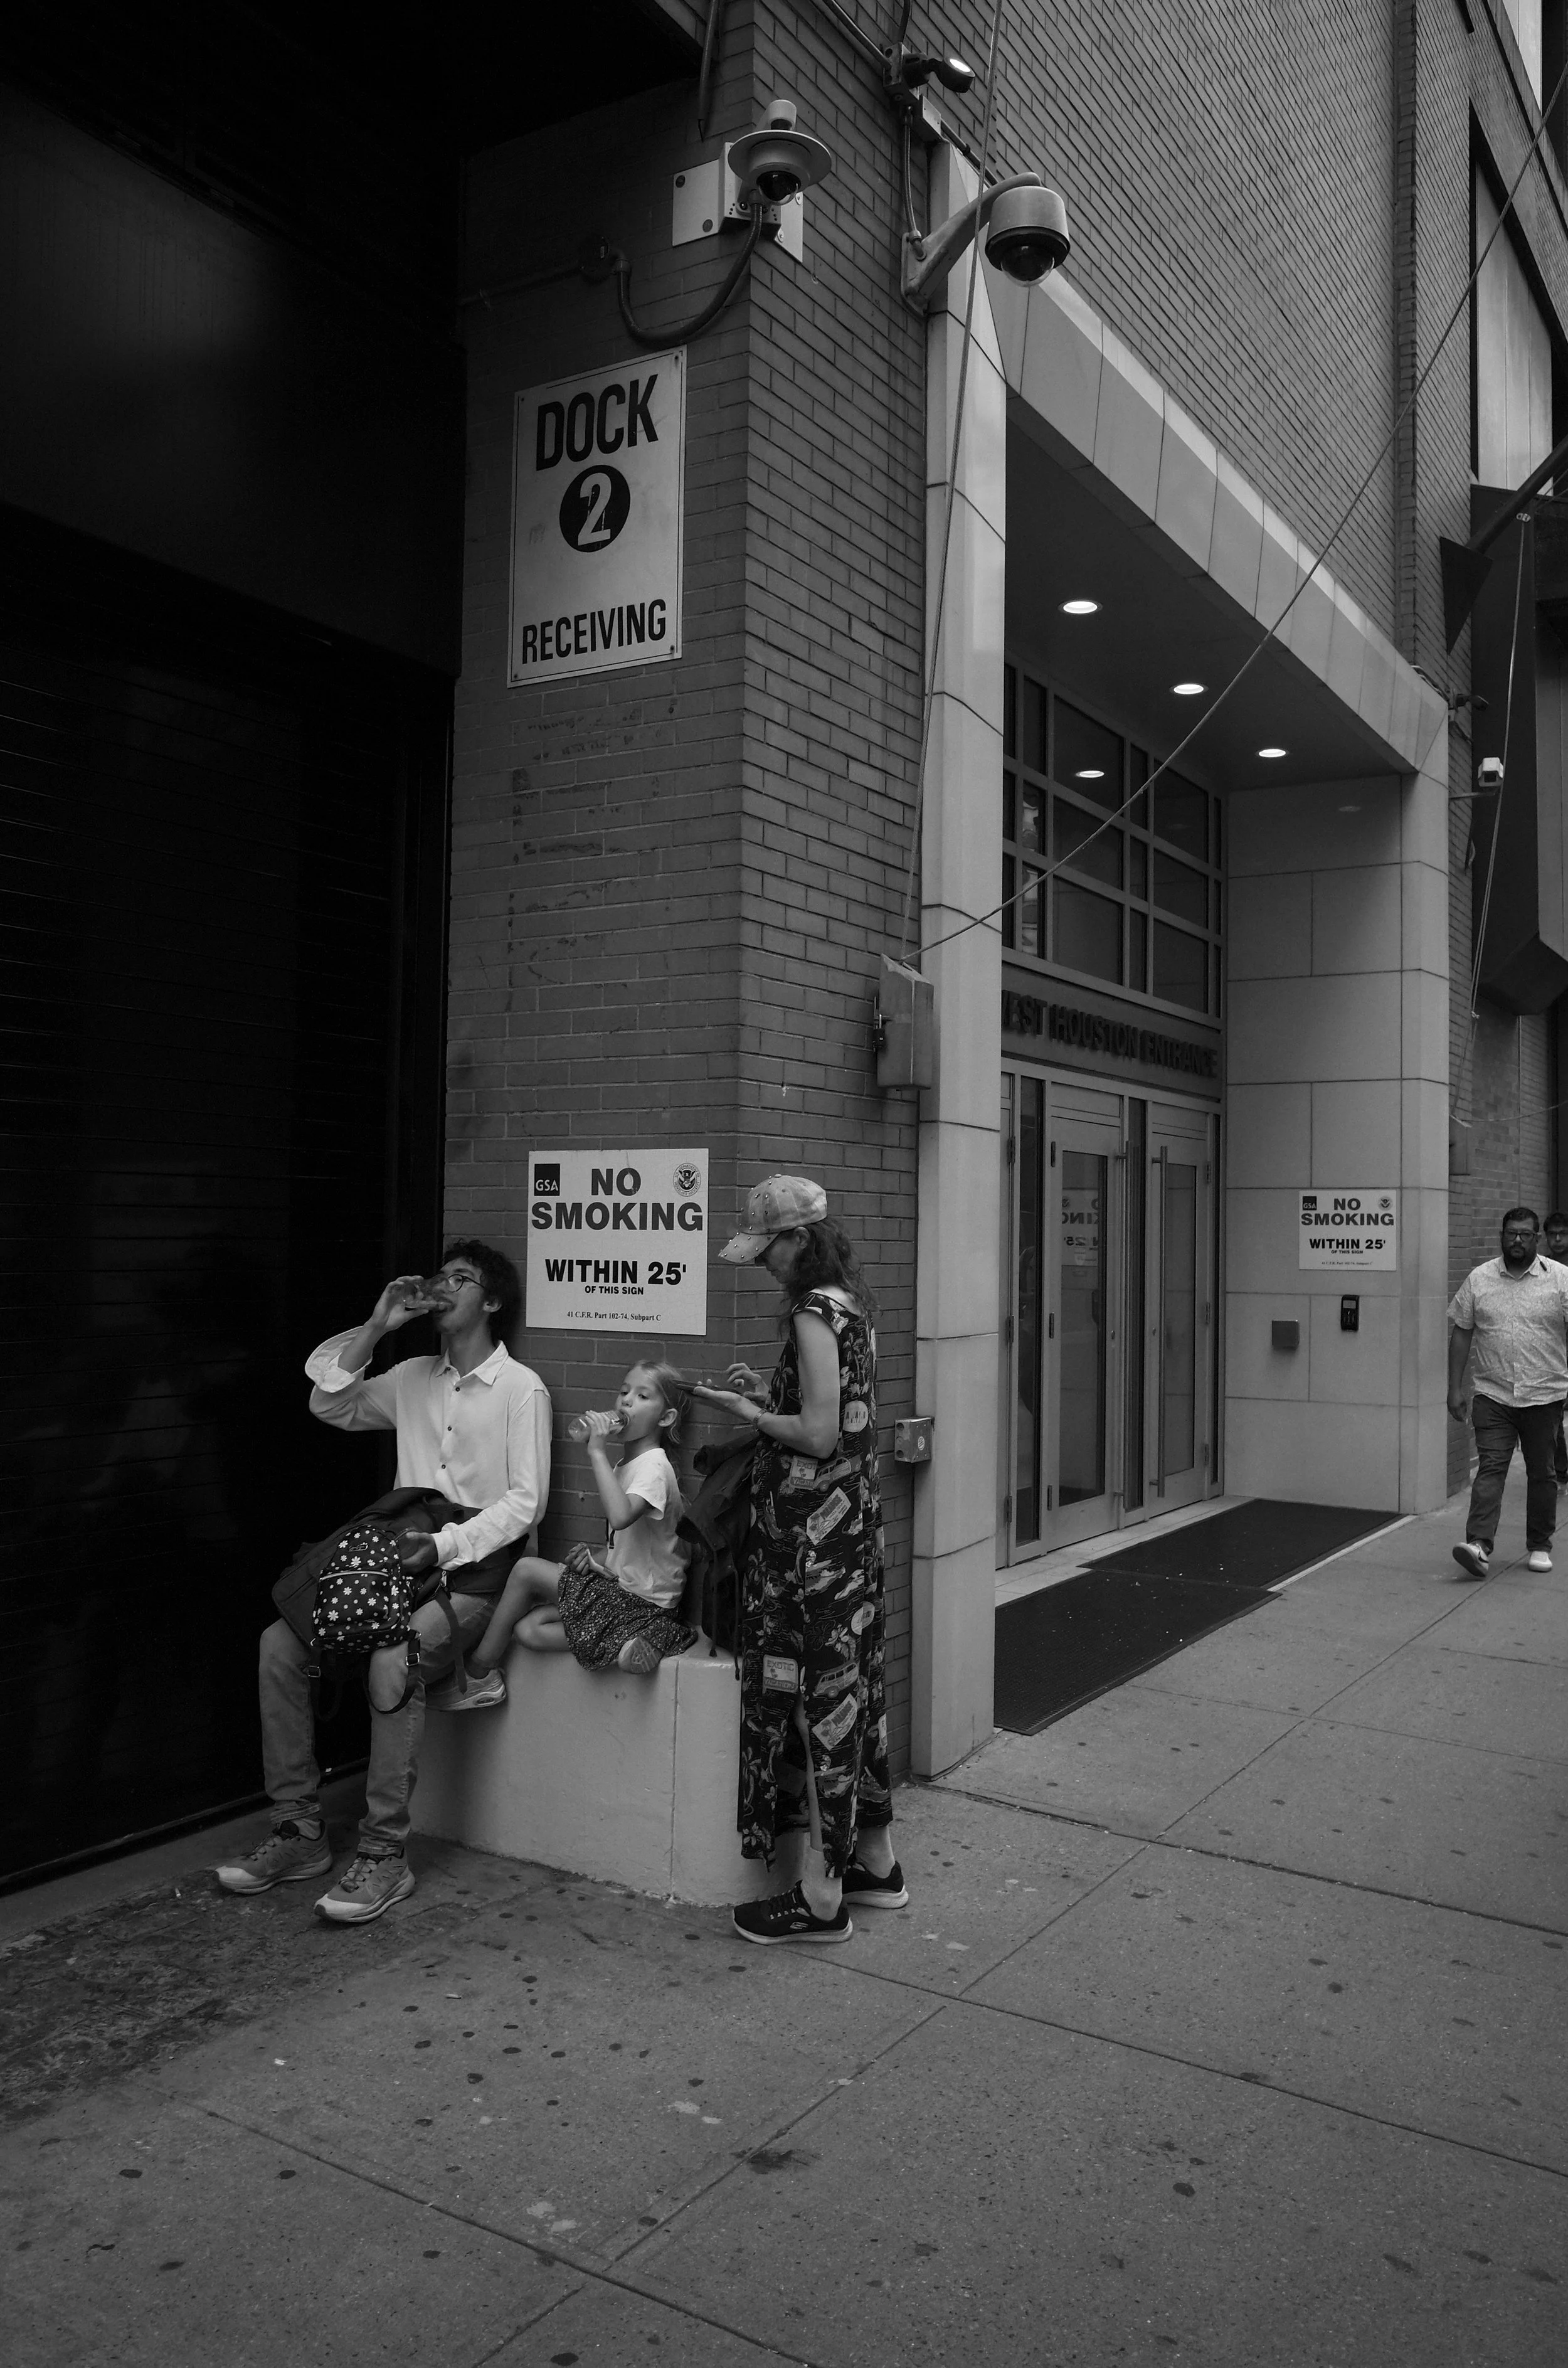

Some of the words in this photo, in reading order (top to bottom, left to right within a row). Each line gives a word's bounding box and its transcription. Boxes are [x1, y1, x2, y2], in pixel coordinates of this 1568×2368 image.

[536, 374, 659, 471] DOCK
[577, 472, 613, 546] 2
[522, 599, 666, 664] RECEIVING
[1049, 1004, 1139, 1063] HOUSTON
[1140, 1029, 1219, 1078] ENTRANCE
[535, 1179, 559, 1192] GSA
[591, 1167, 641, 1196] NO
[531, 1202, 703, 1231] SMOKING
[1333, 1198, 1361, 1211] NO
[1301, 1213, 1394, 1226] SMOKING
[1310, 1238, 1360, 1249] WITHIN
[1365, 1240, 1385, 1249] 25'
[545, 1259, 638, 1283] WITHIN
[647, 1262, 686, 1285] 25'
[767, 1660, 794, 1671] EXOTIC
